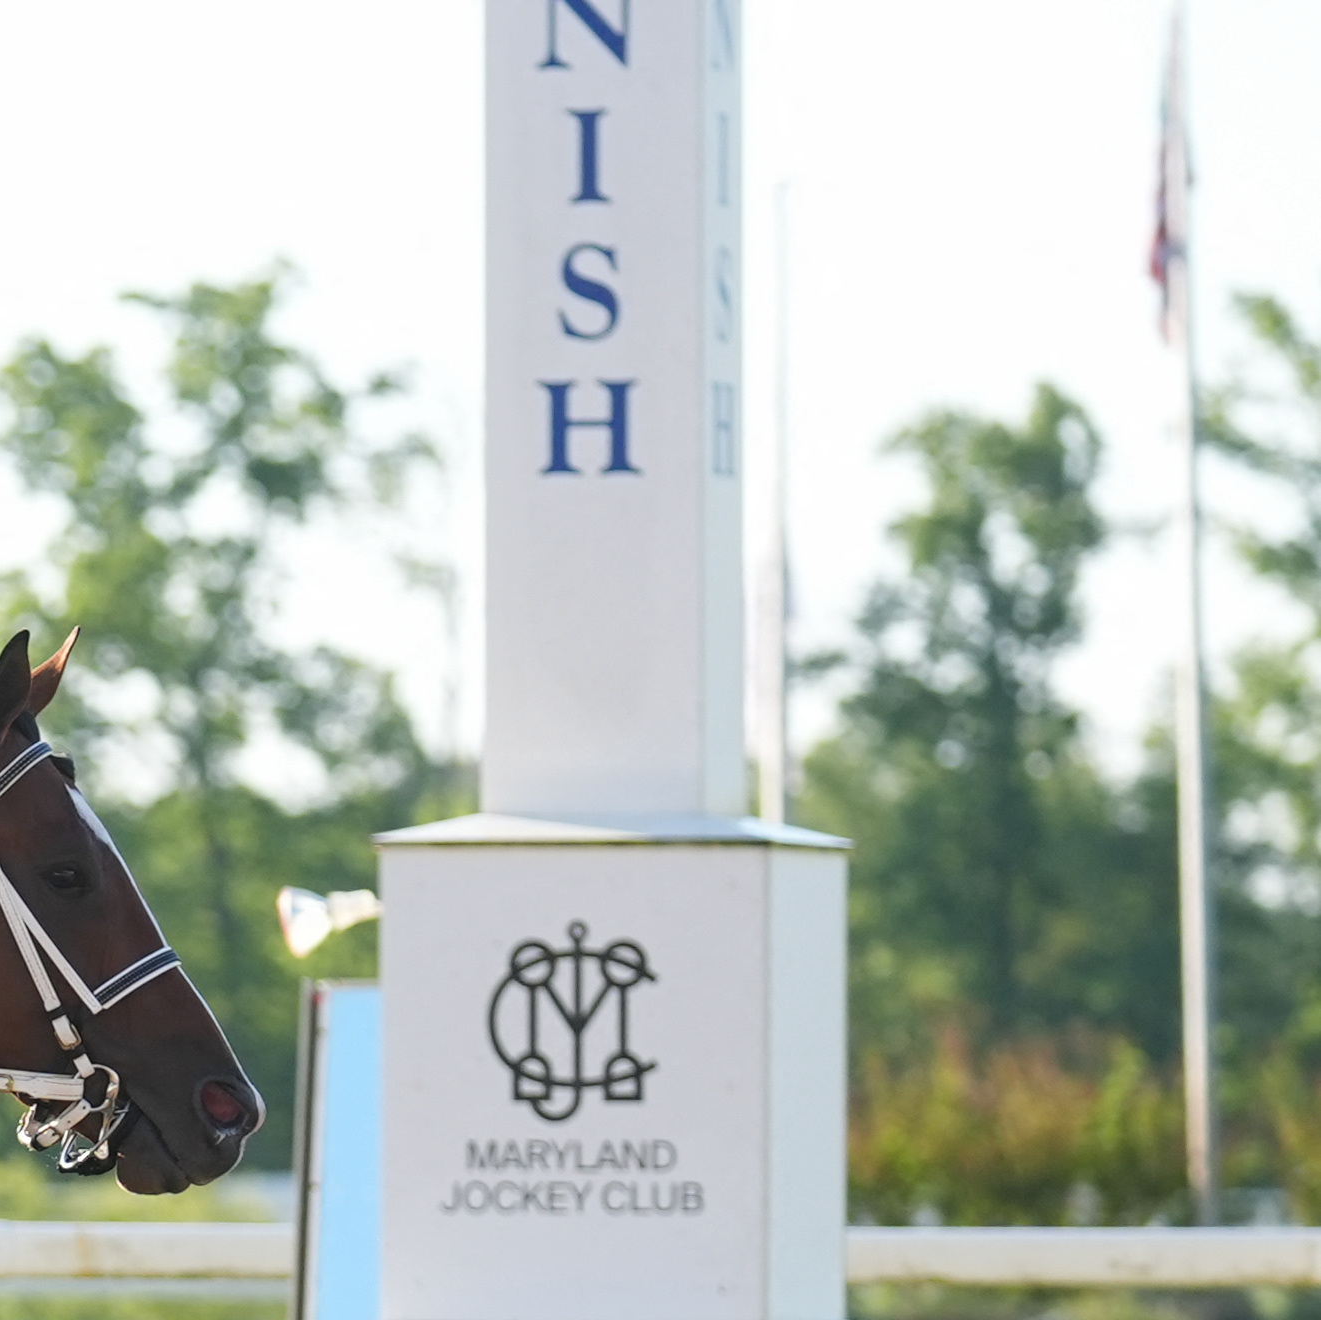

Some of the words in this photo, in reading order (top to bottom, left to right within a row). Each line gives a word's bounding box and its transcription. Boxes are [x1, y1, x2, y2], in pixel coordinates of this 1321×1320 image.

[465, 1138, 679, 1172] MARYLAND
[439, 1179, 594, 1215] JOCKEY
[600, 1179, 705, 1215] CLUB
